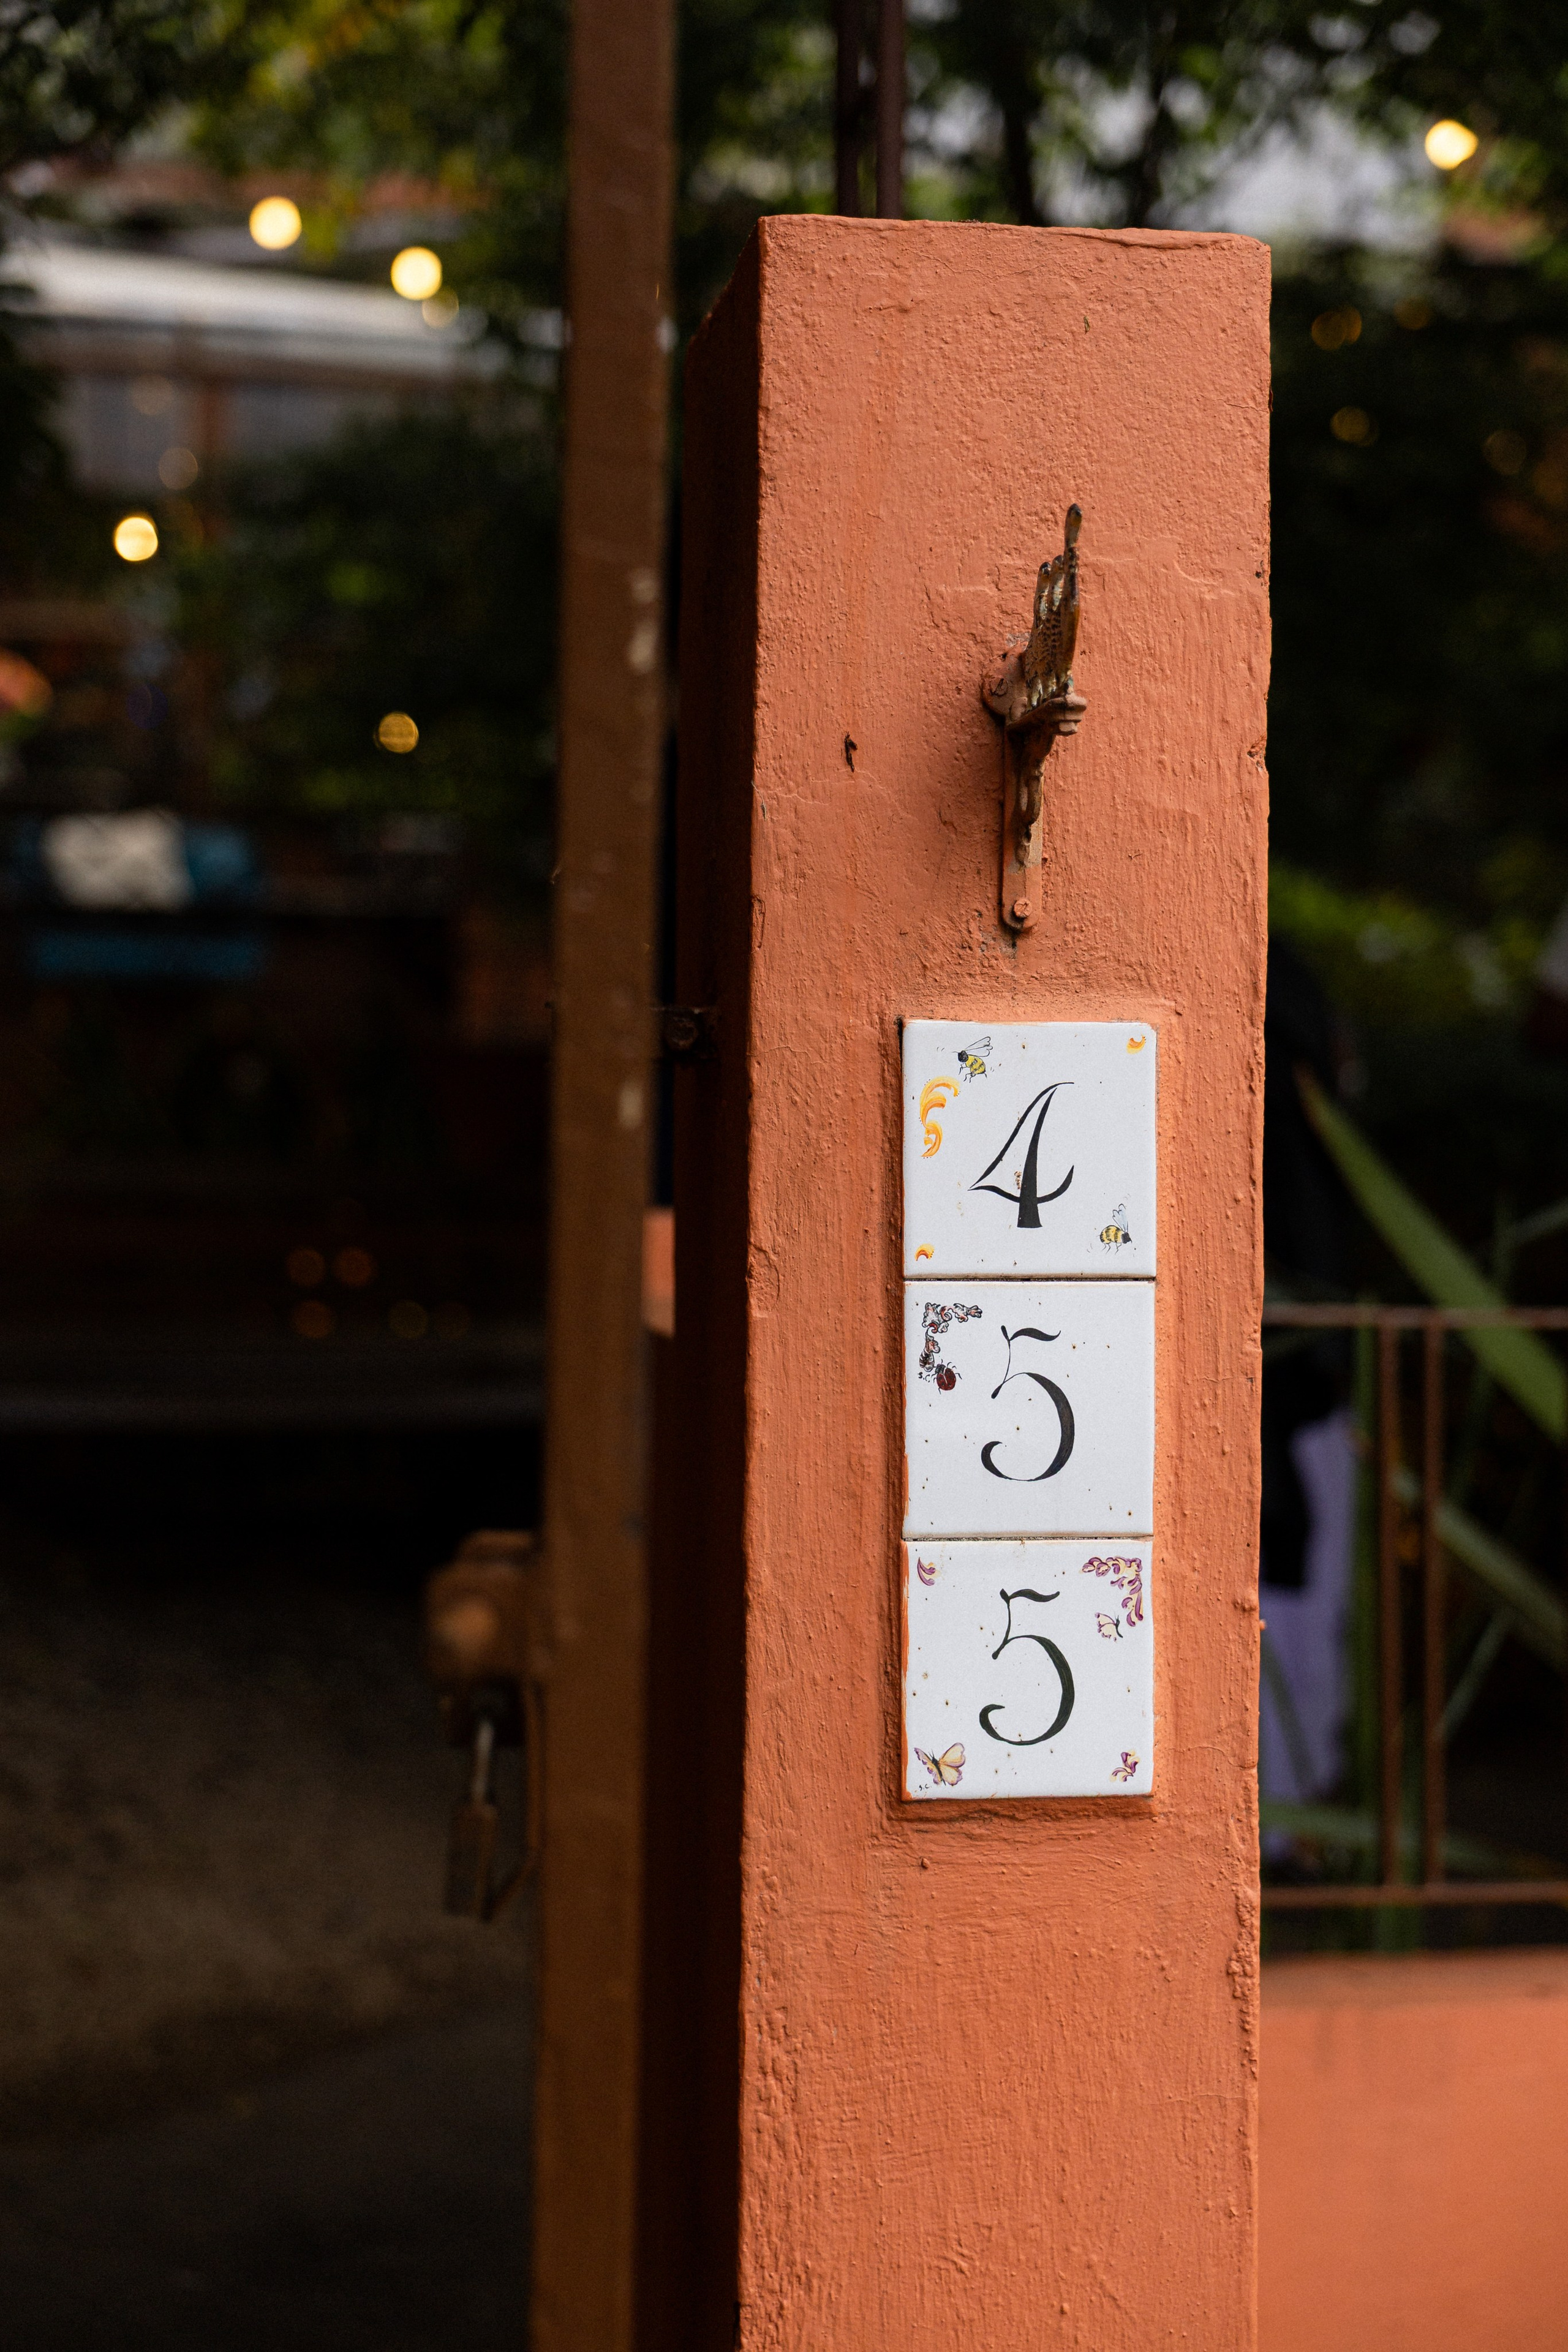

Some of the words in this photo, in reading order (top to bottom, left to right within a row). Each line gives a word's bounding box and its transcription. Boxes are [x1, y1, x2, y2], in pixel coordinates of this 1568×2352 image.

[968, 1082, 1075, 1229] 4
[981, 1325, 1075, 1482] 5
[979, 1588, 1075, 1746] 5
